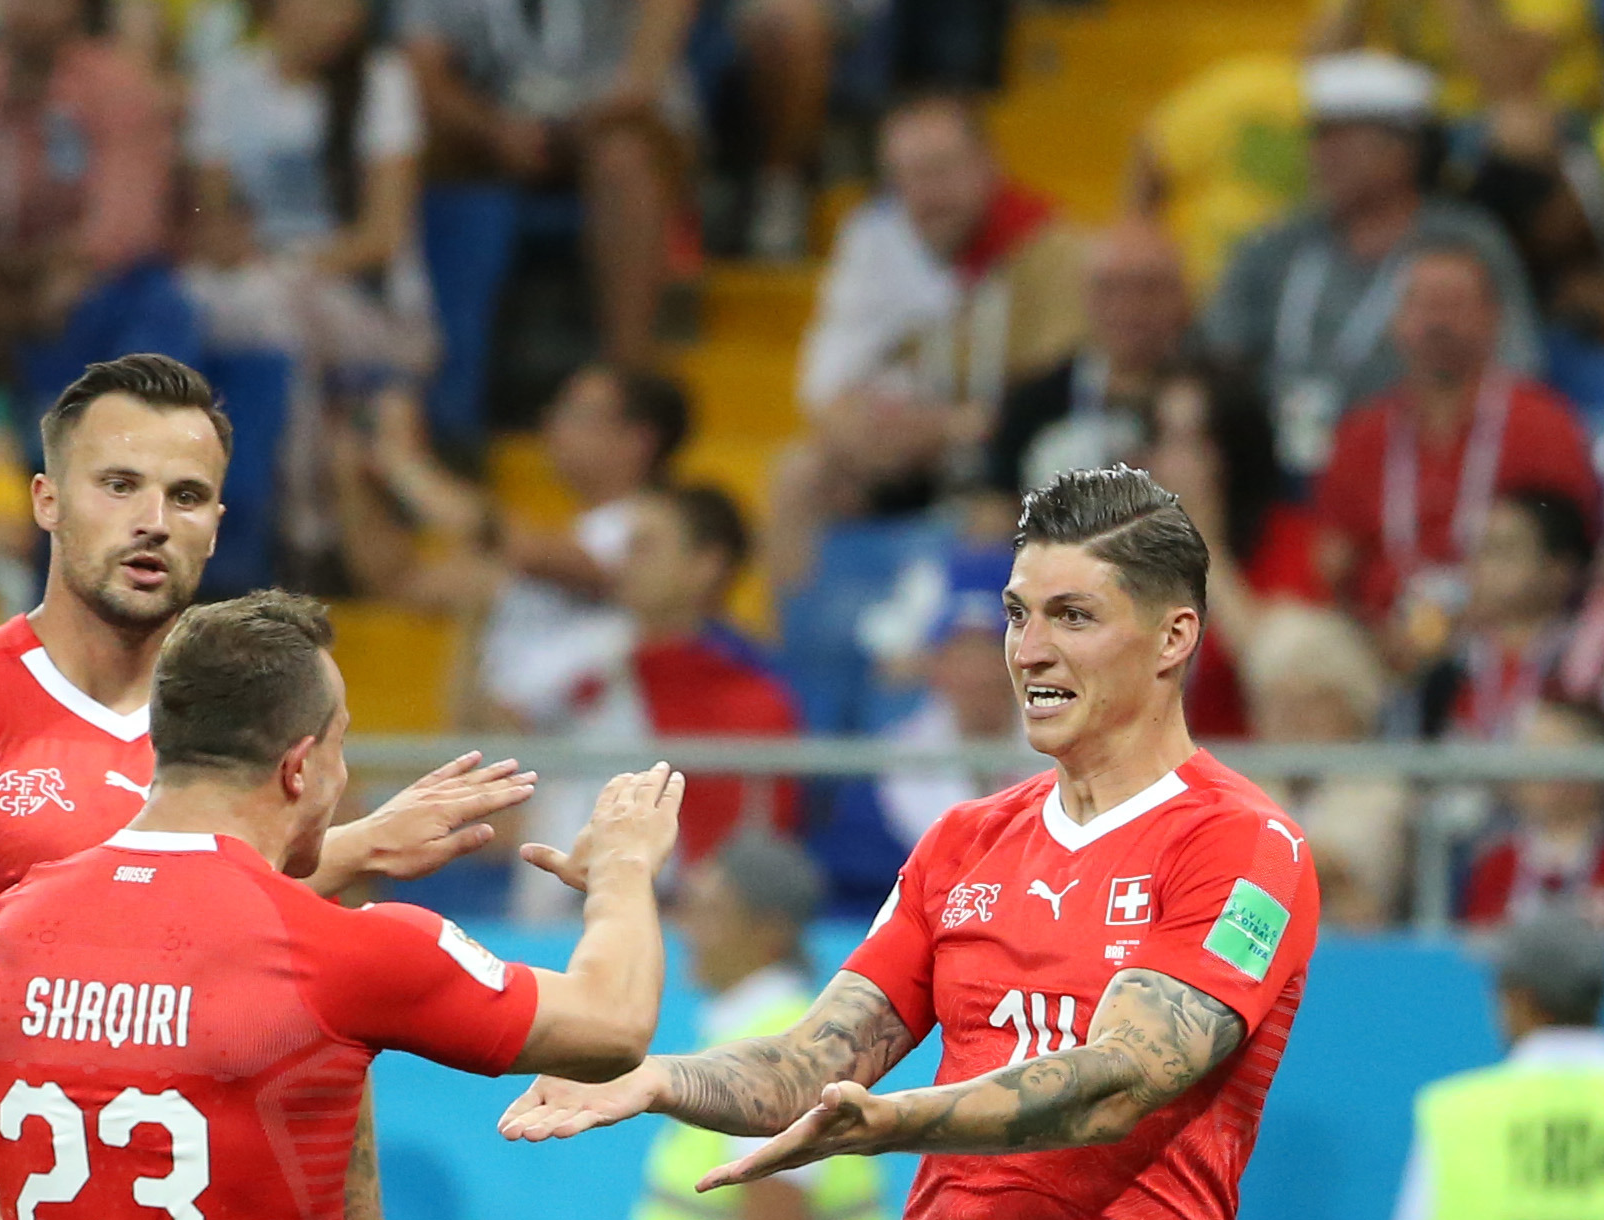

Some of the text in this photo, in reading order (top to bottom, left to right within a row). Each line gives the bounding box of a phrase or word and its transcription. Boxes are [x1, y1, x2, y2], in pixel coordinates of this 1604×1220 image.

[113, 866, 157, 883] SUISSE
[1248, 942, 1269, 960] FIFA
[21, 977, 192, 1048] SHAQIRI
